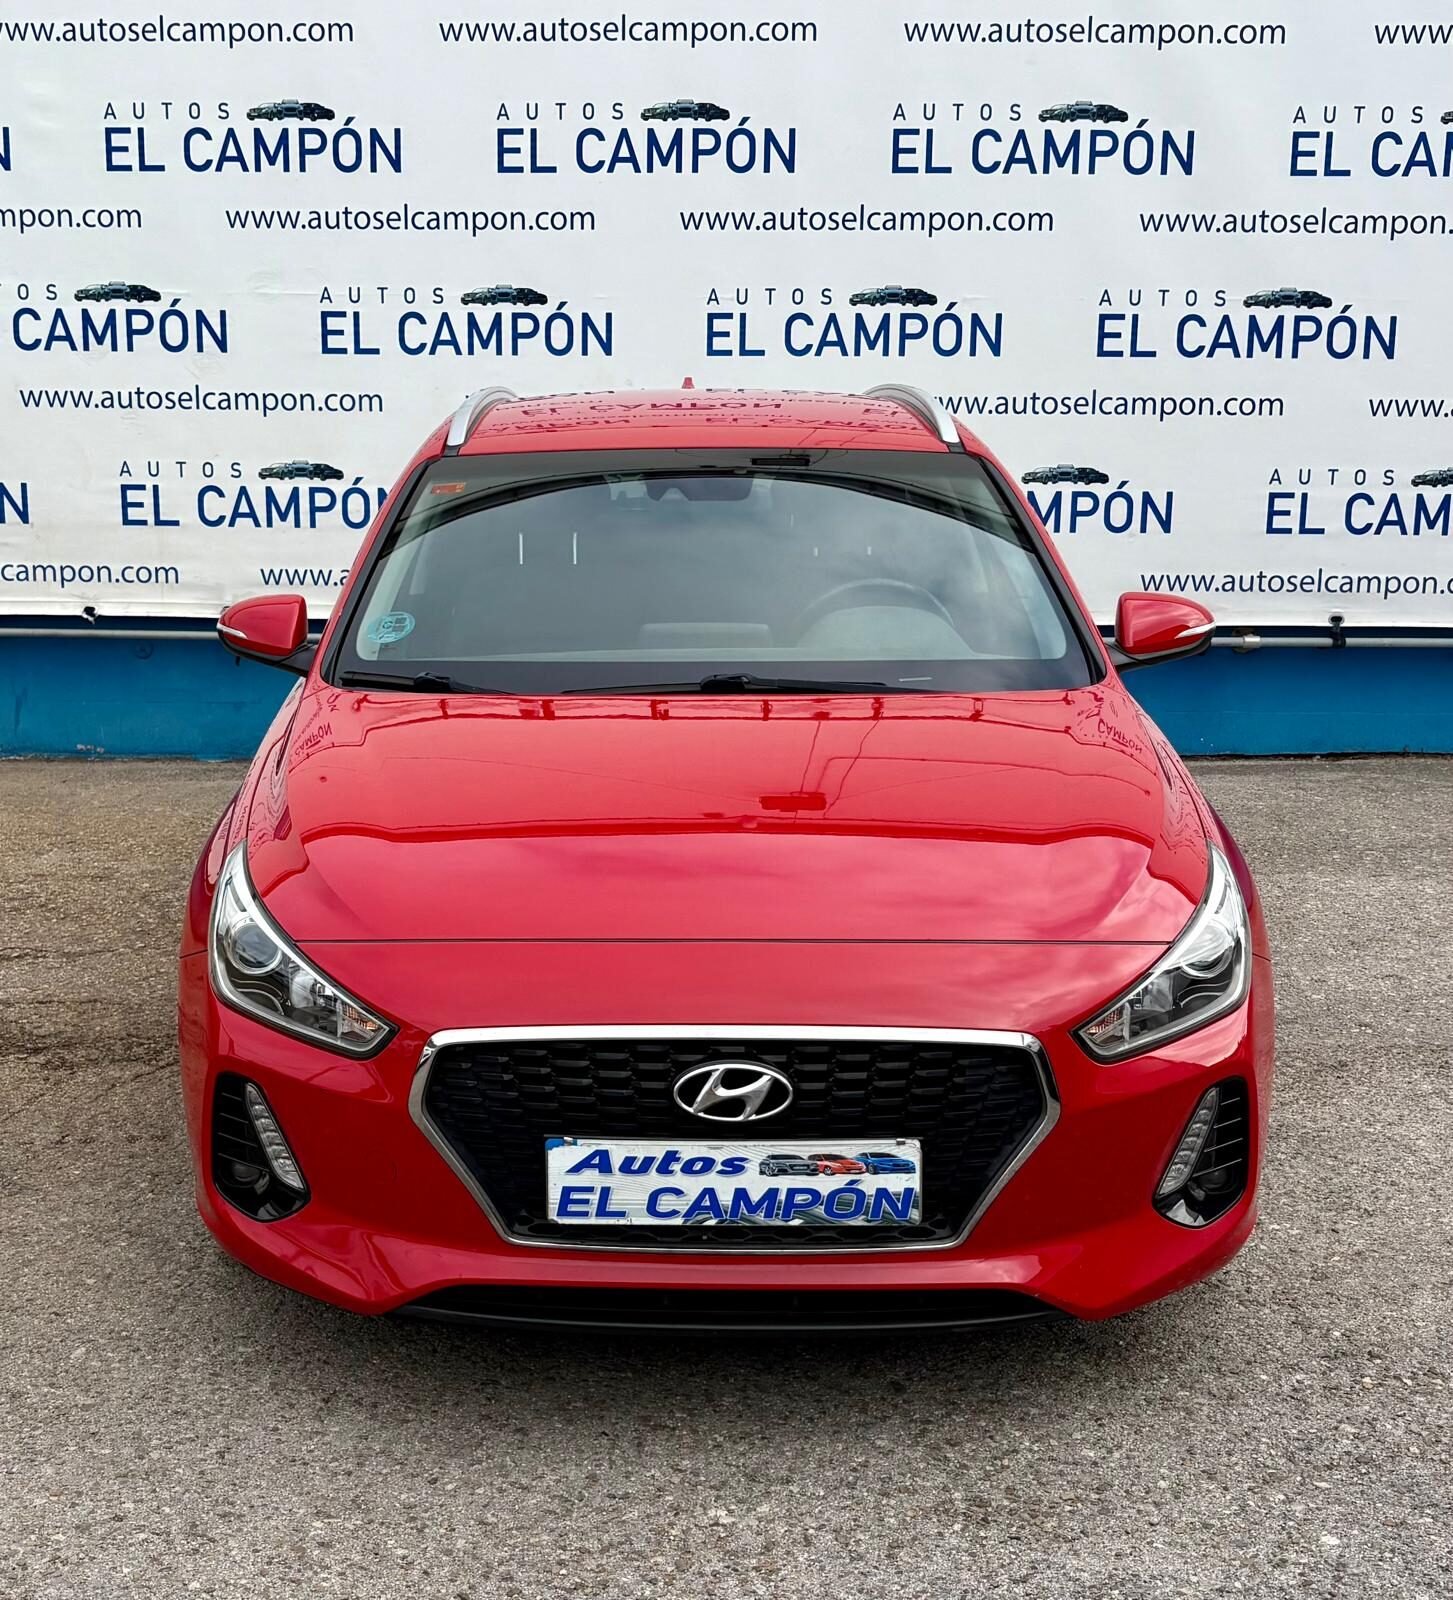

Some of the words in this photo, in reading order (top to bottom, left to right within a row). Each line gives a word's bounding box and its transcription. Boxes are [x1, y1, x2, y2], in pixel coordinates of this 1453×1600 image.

[0, 15, 353, 48] ww.autoselcampon.com
[439, 14, 816, 48] www.autoselcampon.com
[904, 16, 1285, 50] www.autoselcampon.com
[104, 103, 229, 119] AUTOS
[497, 103, 623, 120] AUTOS
[893, 104, 1021, 121] AUTOS
[1293, 106, 1422, 123] AUTOS
[105, 127, 165, 171] EL
[184, 117, 401, 173] CAMPÓN
[497, 128, 557, 173] EL
[576, 117, 795, 173] CAMPÓN
[892, 129, 952, 173] EL
[972, 119, 1194, 175] CAMPÓN
[1290, 131, 1351, 176] EL
[1372, 131, 1453, 177] CA
[226, 204, 594, 237] www.autoselcampon.com
[680, 204, 1053, 237] www.autoselcampon.com
[0, 284, 57, 300] OS
[320, 287, 443, 304] AUTOS
[707, 288, 832, 305] AUTOS
[1099, 289, 1225, 306] AUTOS
[13, 299, 227, 353] CAMPÓN
[321, 311, 380, 355] EL
[399, 301, 612, 356] CAMPÓN
[707, 313, 765, 356] EL
[785, 302, 1002, 357] CAMPÓN
[1097, 314, 1156, 357] EL
[1177, 305, 1397, 359] CAMPÓN
[20, 385, 382, 417] www.autoselcampon.com
[934, 389, 1283, 420] ww.autoselcampon.com
[1369, 400, 1453, 417] www.
[120, 461, 241, 478] AUTOS
[1269, 469, 1394, 485] AUTOS
[121, 484, 180, 526] EL
[198, 477, 388, 529] CAMPÓ
[1266, 492, 1325, 534] EL
[1345, 492, 1451, 536] CAM
[1, 565, 178, 588] campon.com
[565, 1149, 750, 1176] Autos
[556, 1185, 628, 1218] EL
[645, 1179, 916, 1223] CAMPÓN
